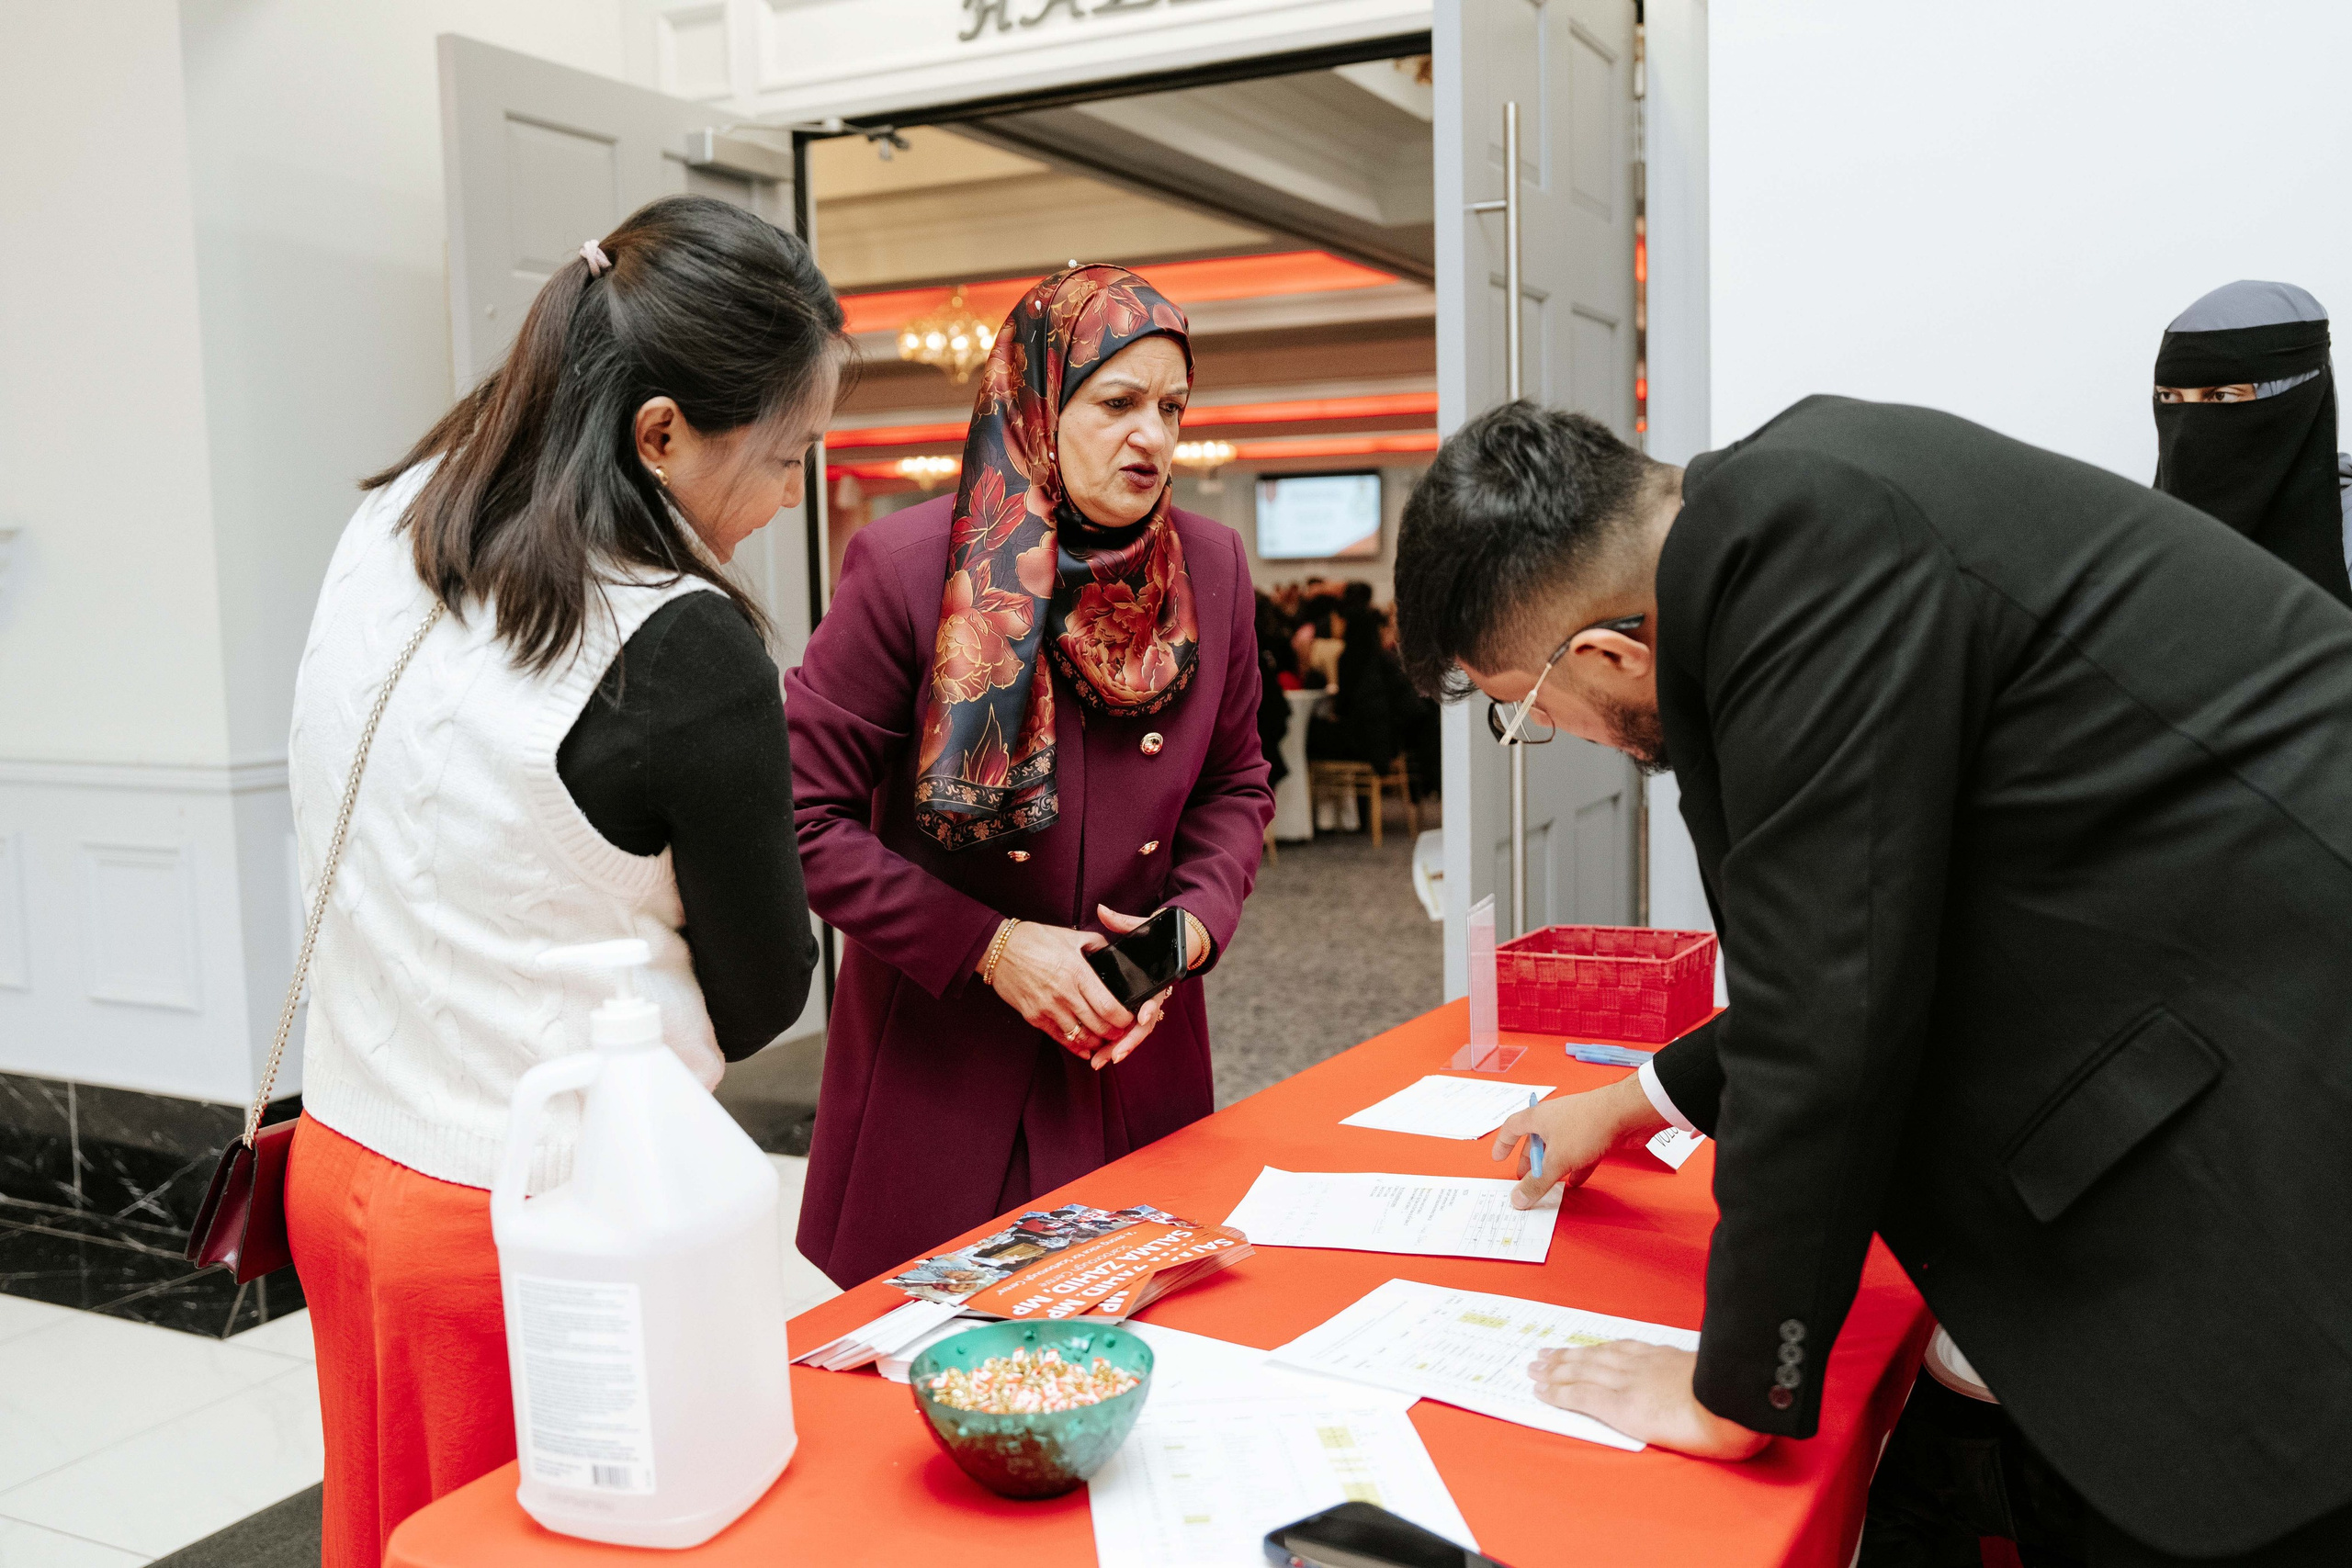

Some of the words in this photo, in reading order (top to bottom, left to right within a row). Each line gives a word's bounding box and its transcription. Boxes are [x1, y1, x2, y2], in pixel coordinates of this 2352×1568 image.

[1083, 1245, 1103, 1255] voice
[1114, 1229, 1193, 1261] SALMA
[1071, 1252, 1086, 1260] for
[1073, 1245, 1133, 1272] Scarborough
[1024, 1258, 1074, 1281] Scarborough
[1038, 1270, 1074, 1287] Centre
[1043, 1259, 1127, 1294] ZAHID,
[1012, 1294, 1054, 1315] MP
[1046, 1298, 1087, 1319] MP
